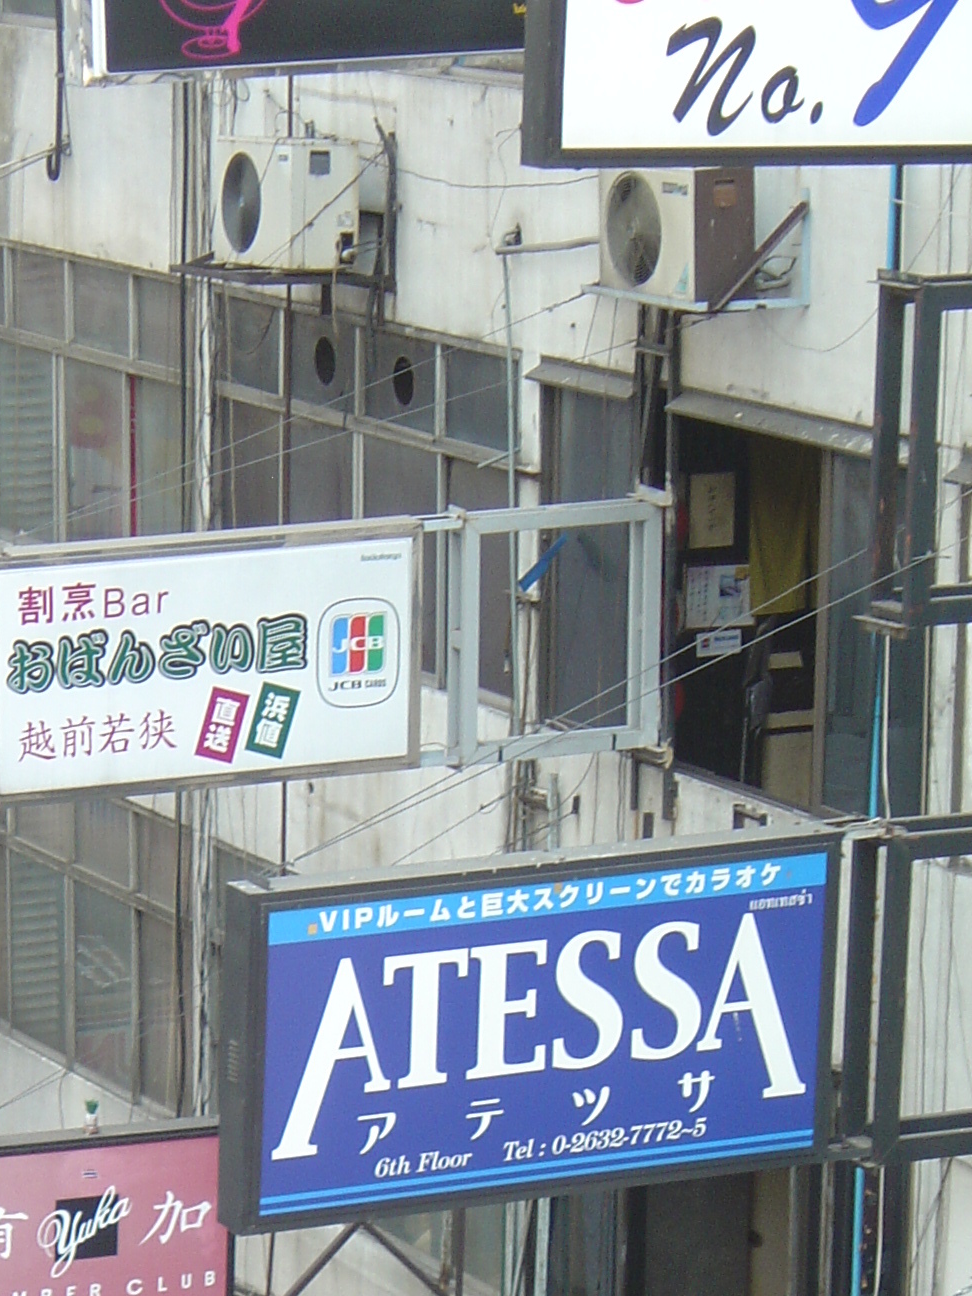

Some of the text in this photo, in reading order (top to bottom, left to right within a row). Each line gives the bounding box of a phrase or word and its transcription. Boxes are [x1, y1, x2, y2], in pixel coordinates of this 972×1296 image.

[667, 16, 824, 137] No.
[6, 611, 308, 694] おばんざい屋
[332, 634, 385, 653] JCB
[328, 680, 362, 691] JCB
[18, 708, 177, 763] 越前若狭
[202, 697, 237, 753] 直送
[271, 911, 807, 1161] ATESSA
[374, 1155, 411, 1179] 6th
[417, 1148, 473, 1172] Floor
[138, 1190, 212, 1246] 加
[126, 1270, 217, 1296] CLUB
